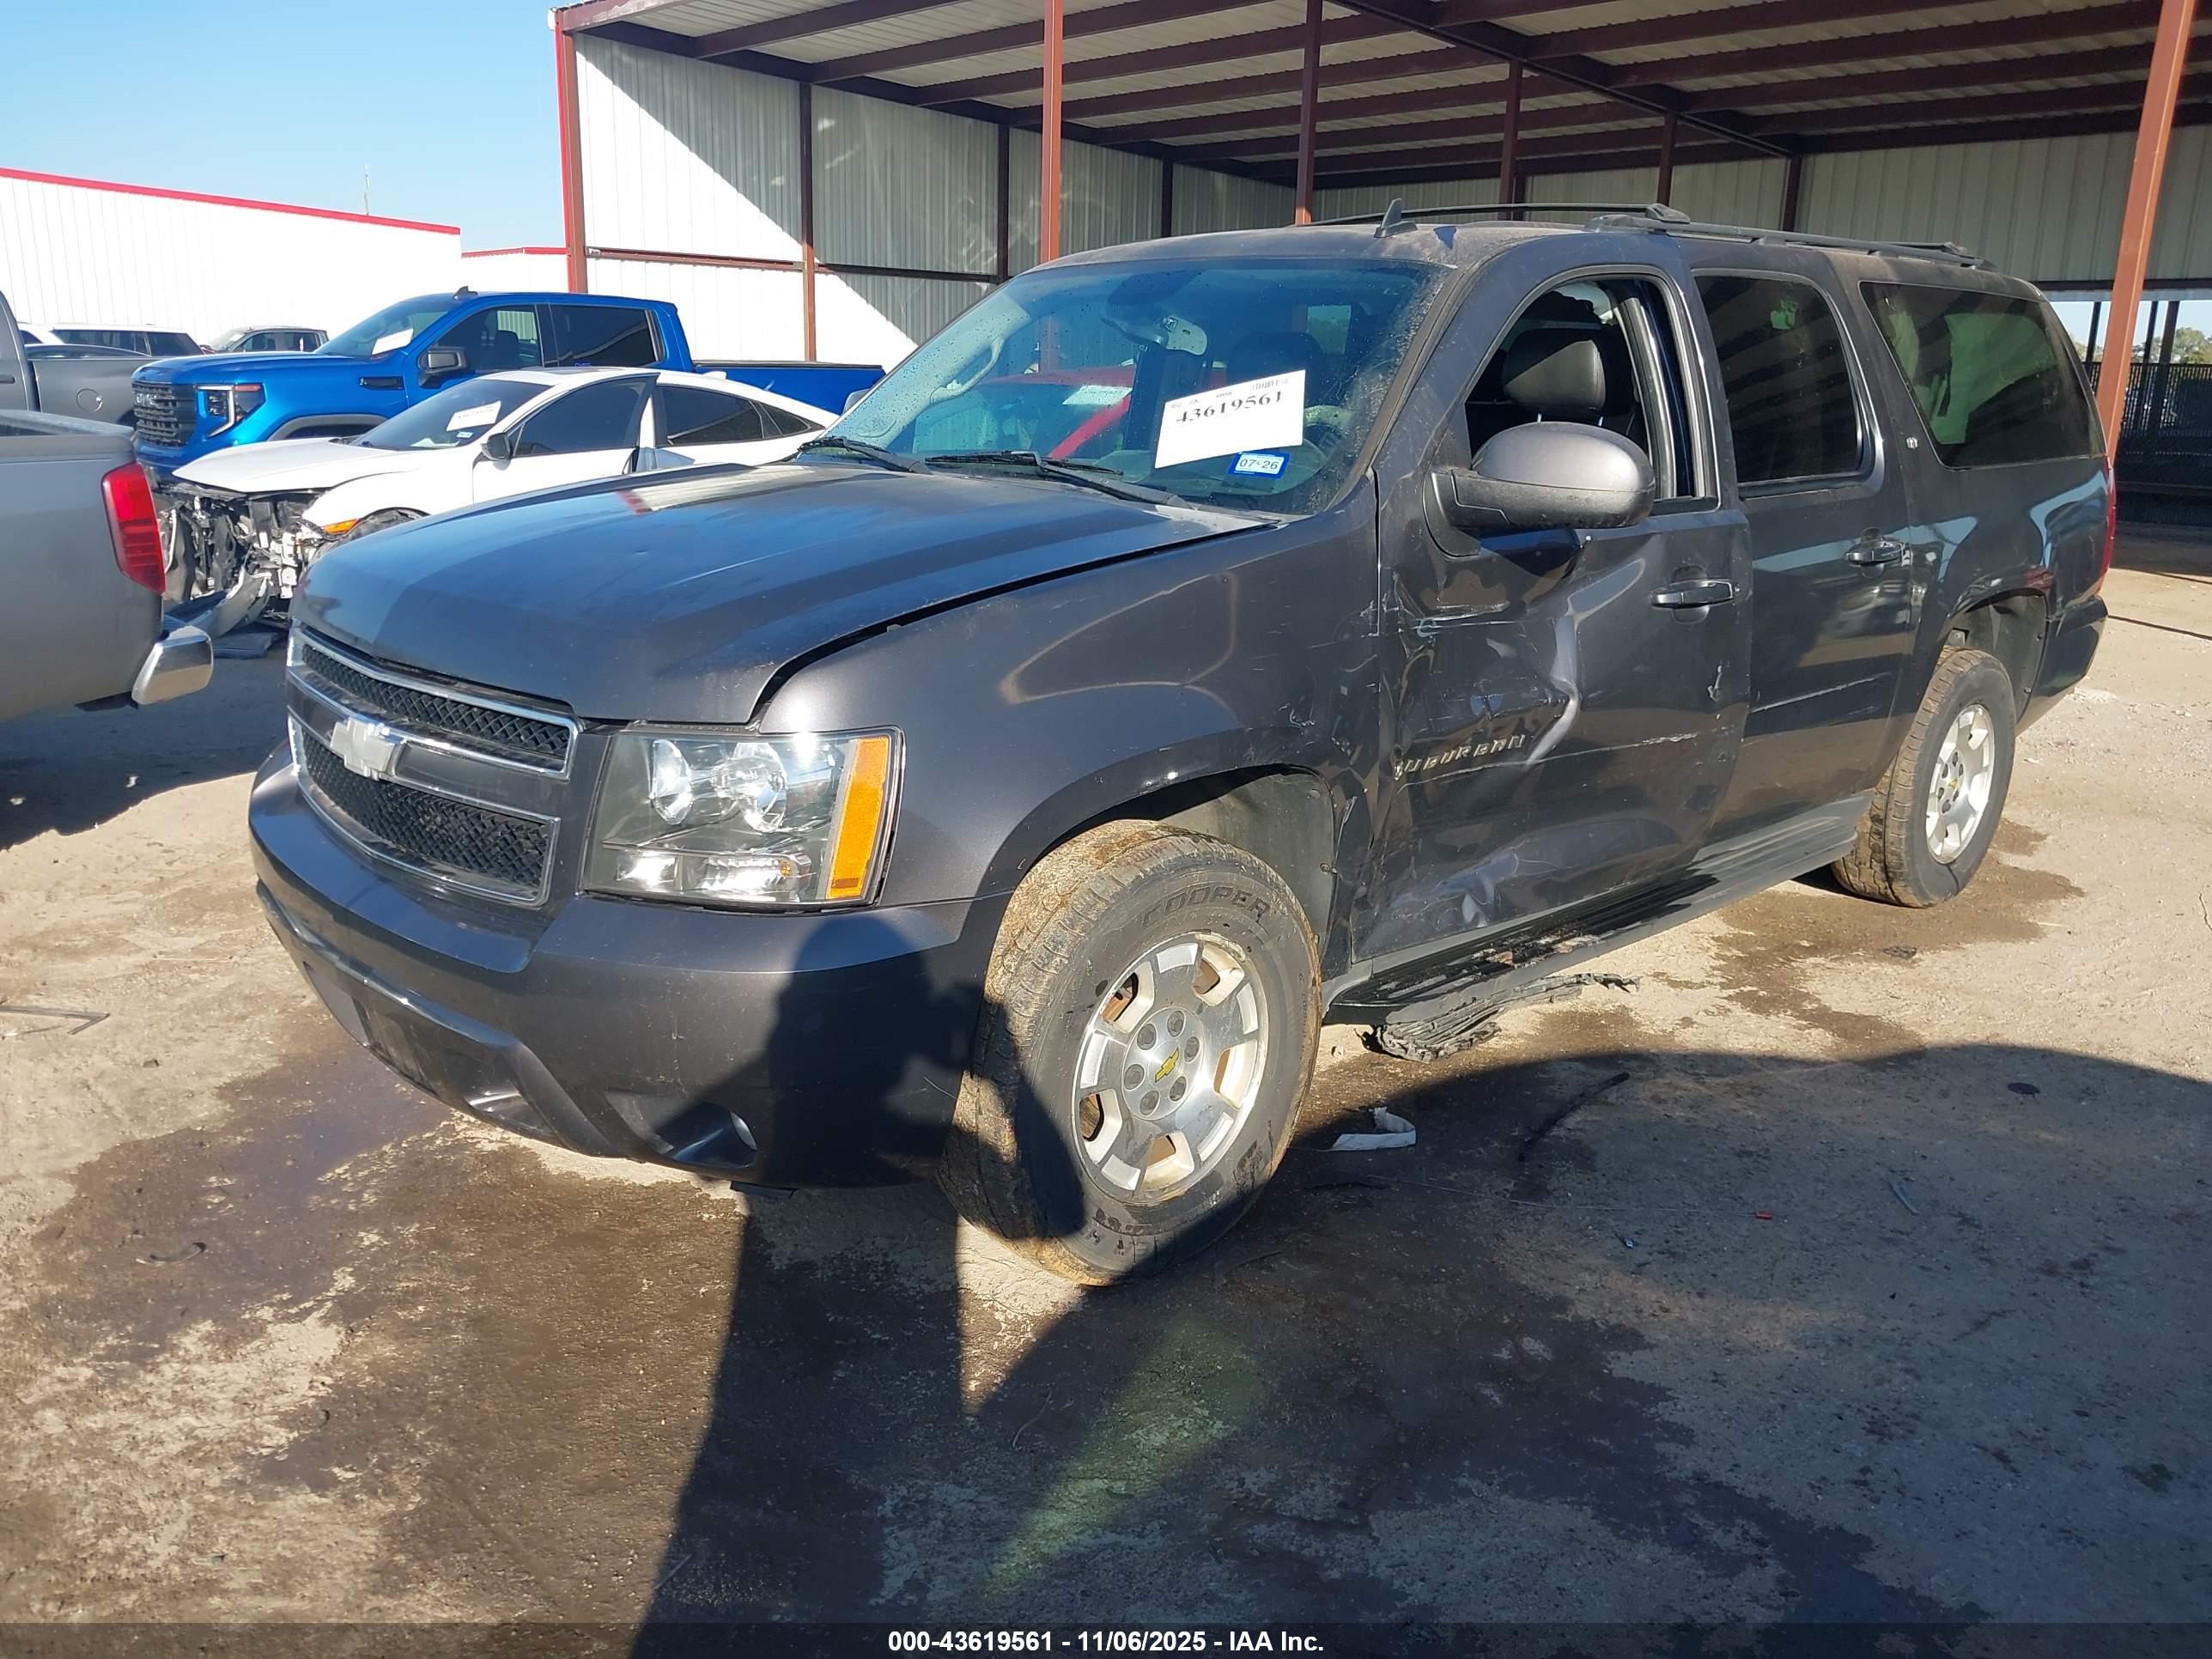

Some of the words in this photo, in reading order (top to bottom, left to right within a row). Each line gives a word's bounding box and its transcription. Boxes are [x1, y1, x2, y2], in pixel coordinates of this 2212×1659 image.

[1176, 391, 1282, 422] 43619561
[1239, 459, 1258, 468] 07
[1261, 460, 1279, 470] 26
